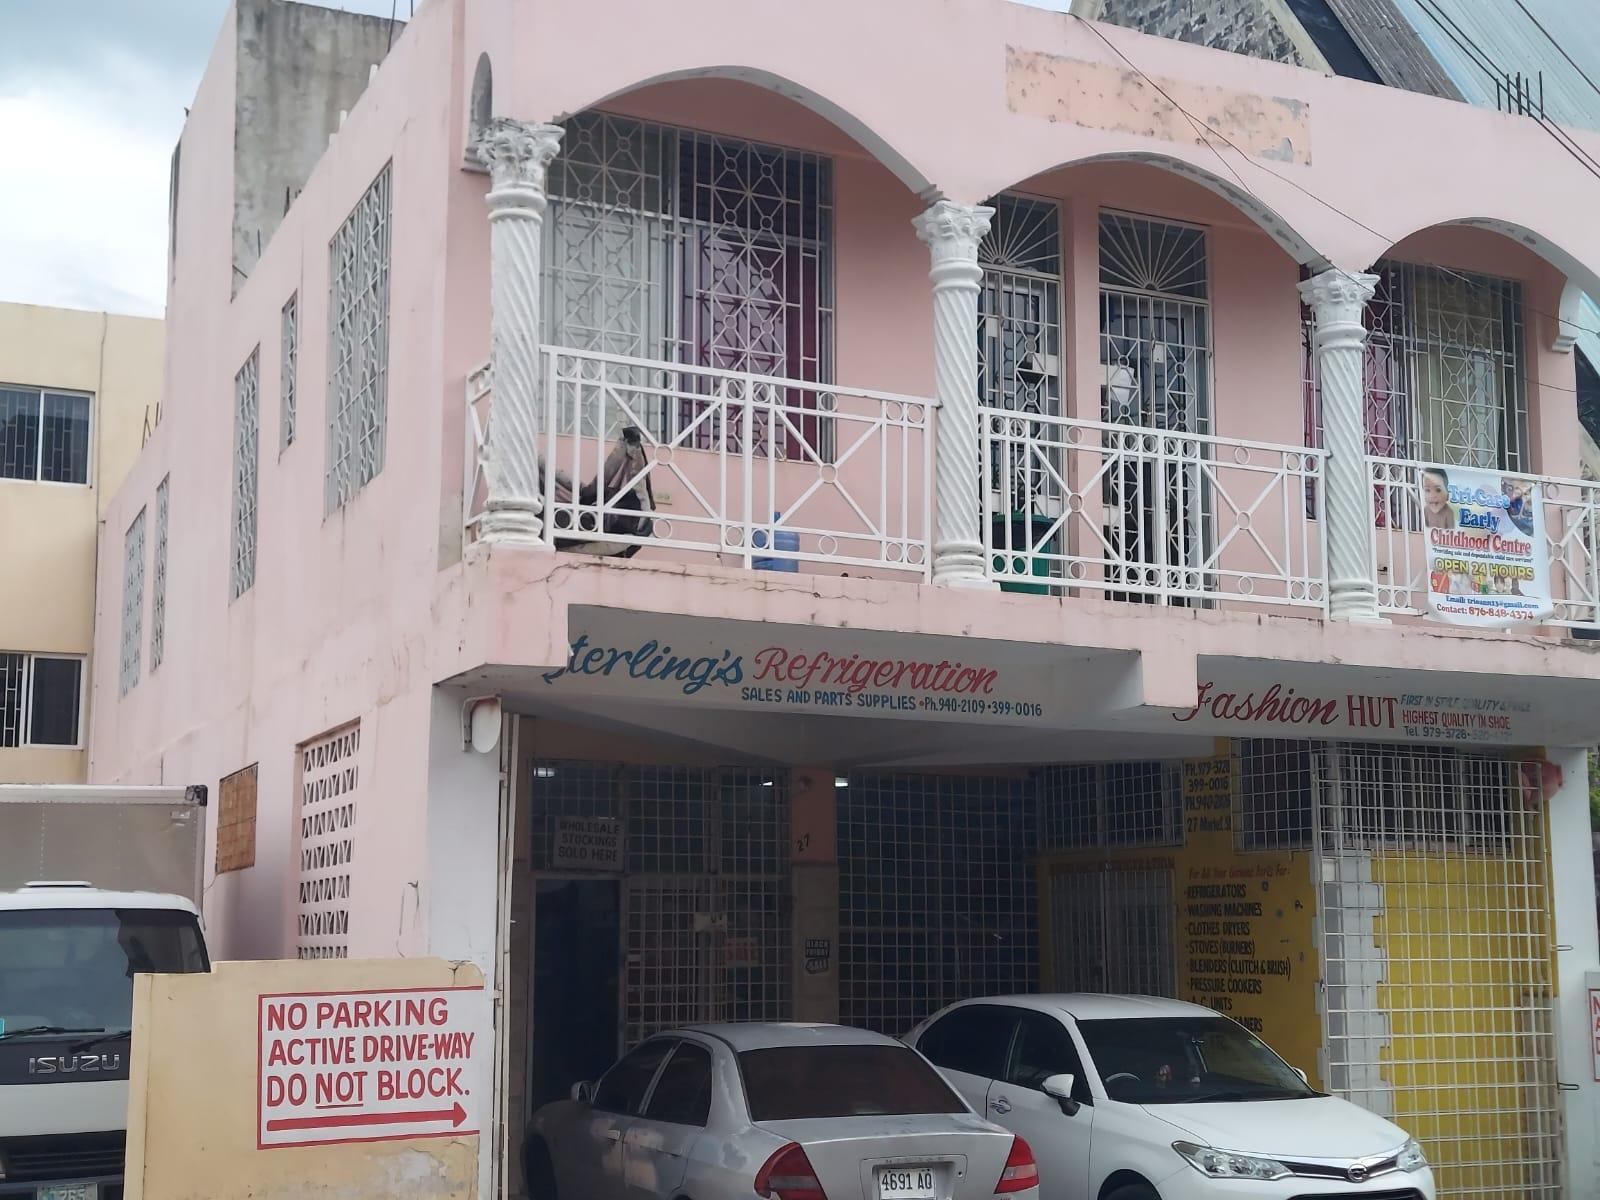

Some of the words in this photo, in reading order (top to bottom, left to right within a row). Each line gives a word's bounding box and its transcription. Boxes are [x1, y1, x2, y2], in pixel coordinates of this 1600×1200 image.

[1449, 485, 1510, 508] Tri-Care
[1459, 508, 1500, 533] Early
[1431, 528, 1490, 551] Childhood
[1493, 535, 1531, 555] Centre
[1435, 557, 1469, 574] OPEN
[1471, 561, 1487, 576] 24
[1490, 563, 1535, 580] HOURS
[1437, 604, 1467, 615] Contact:
[543, 635, 743, 694] terling's
[753, 647, 997, 694] Refrigeration
[741, 687, 782, 702] SALES
[787, 689, 811, 704] AND
[814, 690, 851, 706] PARTS
[857, 693, 917, 711] SUPPLIES
[1400, 694, 1424, 706] FIRST
[1346, 694, 1398, 729] HUT
[1402, 709, 1439, 725] HIGHEST
[1441, 712, 1476, 728] QUALITY
[1478, 714, 1487, 727] IN
[1488, 715, 1511, 730] SHOE
[560, 820, 620, 834] WHOLESALE
[1187, 817, 1199, 833] 27
[561, 833, 617, 848] STOCKINGS
[558, 846, 588, 859] SOLD
[591, 849, 617, 862] HERE
[1187, 884, 1247, 899] REFRIGERATORS
[1187, 904, 1222, 917] WASHING
[1224, 902, 1262, 917] MACHINES
[1188, 922, 1219, 936] CLOTHES
[1222, 922, 1250, 936] DRYERS
[1189, 941, 1219, 955] STOVES
[1189, 959, 1228, 974] BLENDERS
[1228, 957, 1259, 977] (CLUTCH
[1190, 978, 1225, 992] PRESSURE
[1227, 979, 1262, 994] COOKERS
[267, 1002, 308, 1031] NO
[316, 997, 449, 1030] PARKING
[268, 1036, 356, 1067] ACTIVE
[363, 1032, 475, 1063] DRIVE-WAY
[29, 1054, 120, 1074] ISUZU
[267, 1073, 307, 1107] DO
[315, 1071, 368, 1104] NOT
[377, 1067, 470, 1101] BLOCK.
[882, 1172, 913, 1191] 4691
